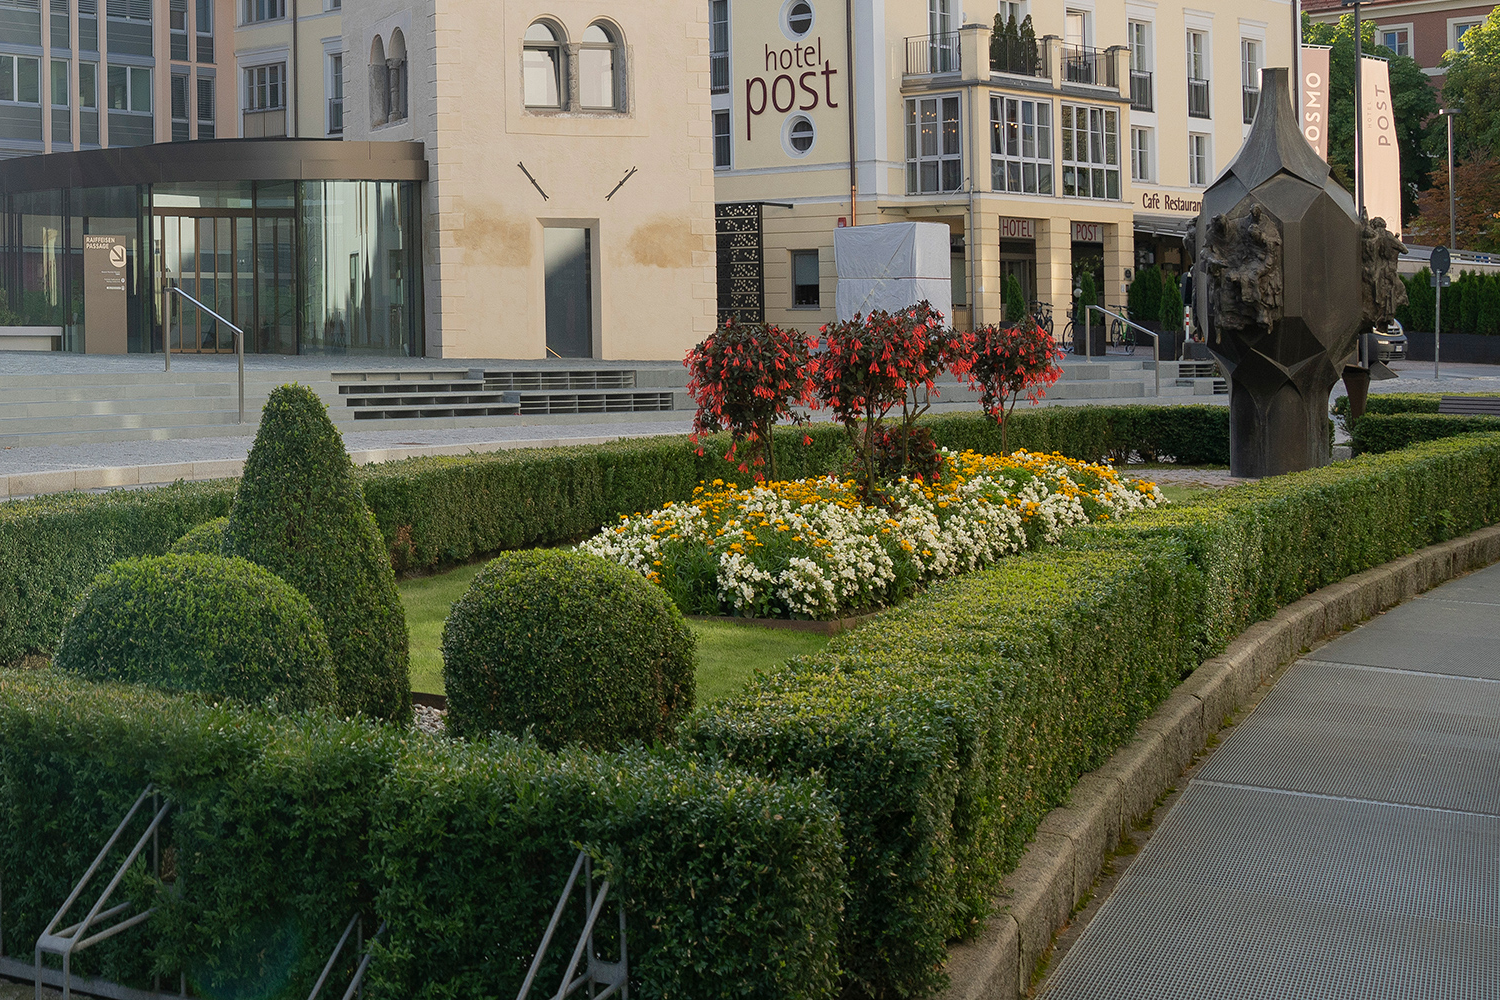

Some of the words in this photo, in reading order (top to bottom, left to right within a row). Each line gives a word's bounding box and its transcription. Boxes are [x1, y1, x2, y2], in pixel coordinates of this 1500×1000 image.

[765, 37, 821, 71] hotel
[746, 59, 838, 141] post
[1375, 85, 1391, 146] POST
[1164, 194, 1203, 212] Restauran
[1002, 219, 1032, 238] HOTEL
[1076, 223, 1098, 241] POST
